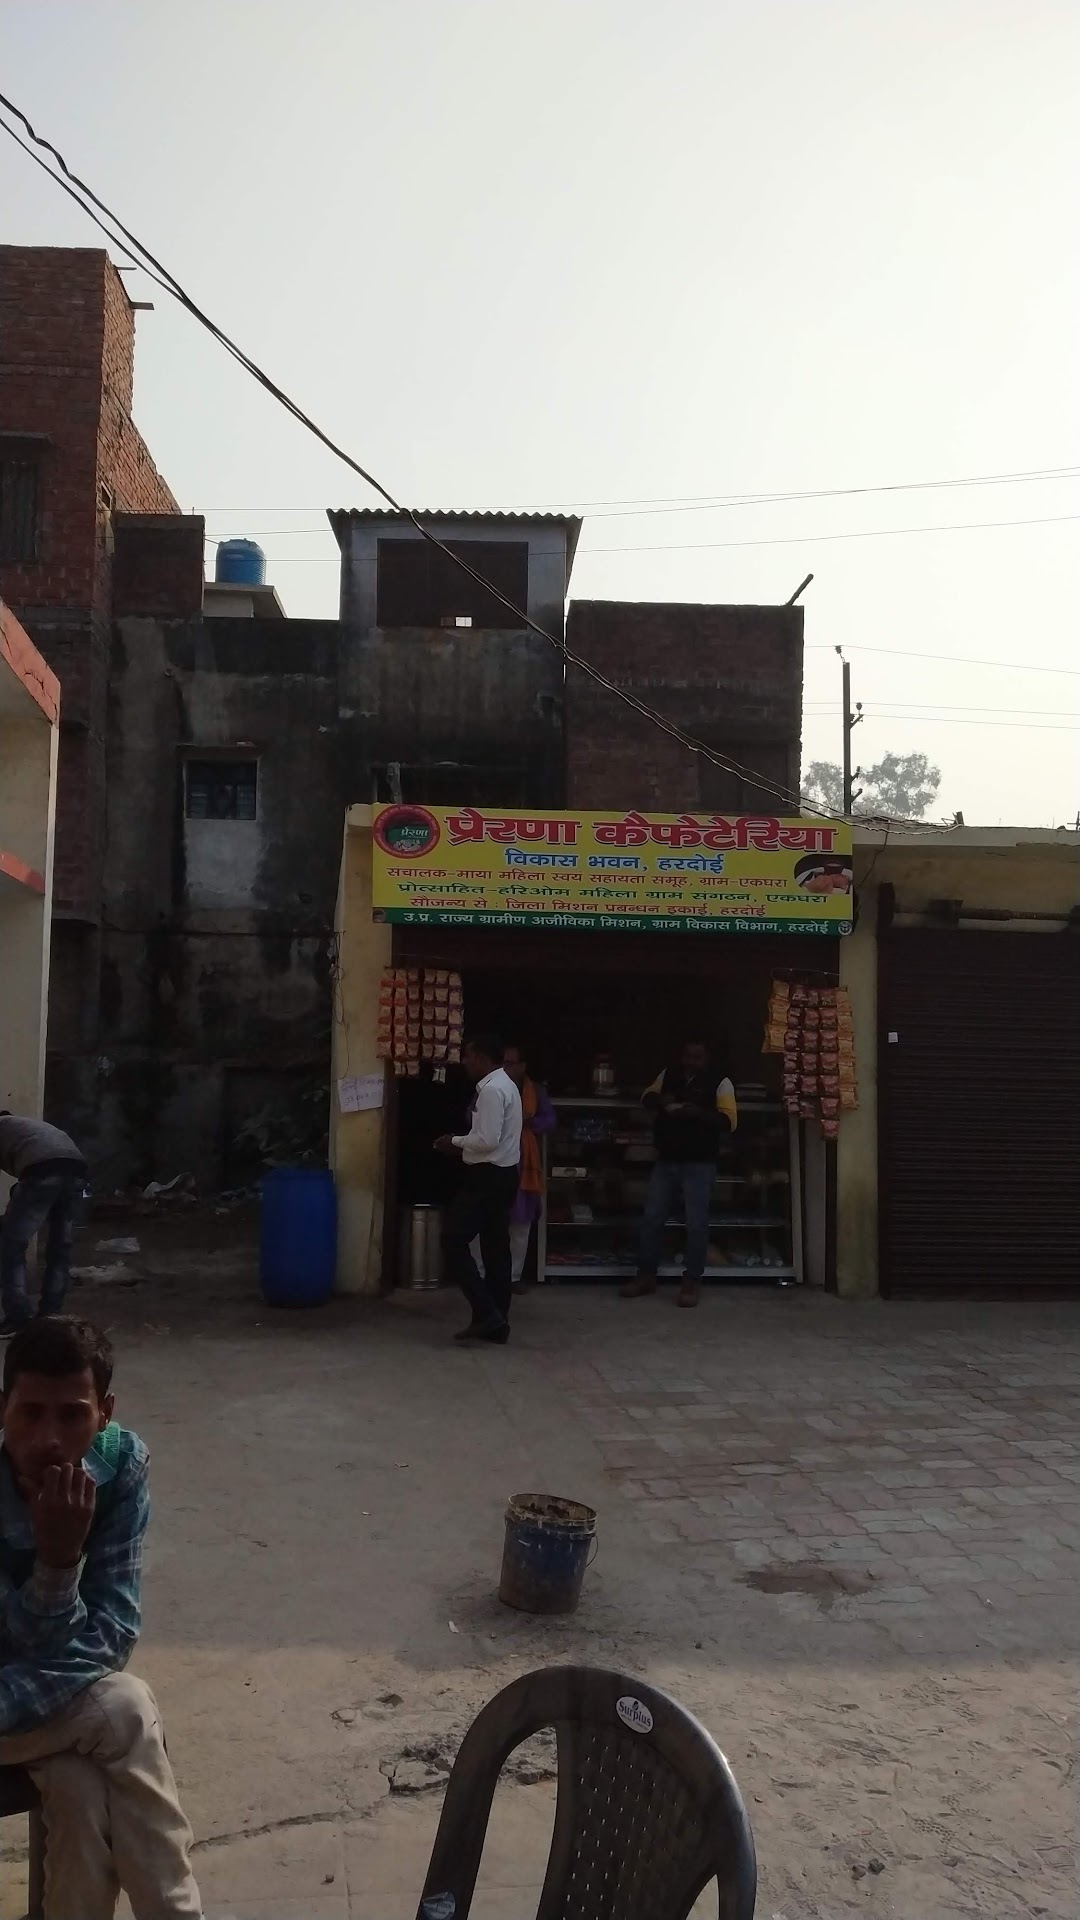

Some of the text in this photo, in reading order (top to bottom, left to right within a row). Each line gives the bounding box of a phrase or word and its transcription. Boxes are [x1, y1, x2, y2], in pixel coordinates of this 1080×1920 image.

[444, 807, 582, 846] प्रेरणा
[505, 848, 724, 873] विकास भवन, हरदोई
[498, 869, 546, 881] महिला
[551, 871, 583, 882] स्वयं
[589, 873, 646, 884] सहायता
[578, 887, 638, 899] महिला
[645, 891, 684, 900] ग्राम
[409, 896, 467, 908] सौजन्य
[473, 897, 488, 908] से
[505, 898, 546, 911] जिला
[551, 899, 599, 912] मिशन
[605, 903, 660, 914] प्रबन्धन
[720, 905, 767, 918] हरदोई
[439, 914, 475, 924] राज्य
[479, 913, 526, 925] ग्रामीण
[600, 917, 647, 930] मिशन,
[652, 919, 681, 929] ग्राम
[686, 919, 731, 930] विकास
[735, 919, 783, 934] विभाग,
[788, 921, 829, 934] हरदोई
[619, 1701, 651, 1727] Surplus
